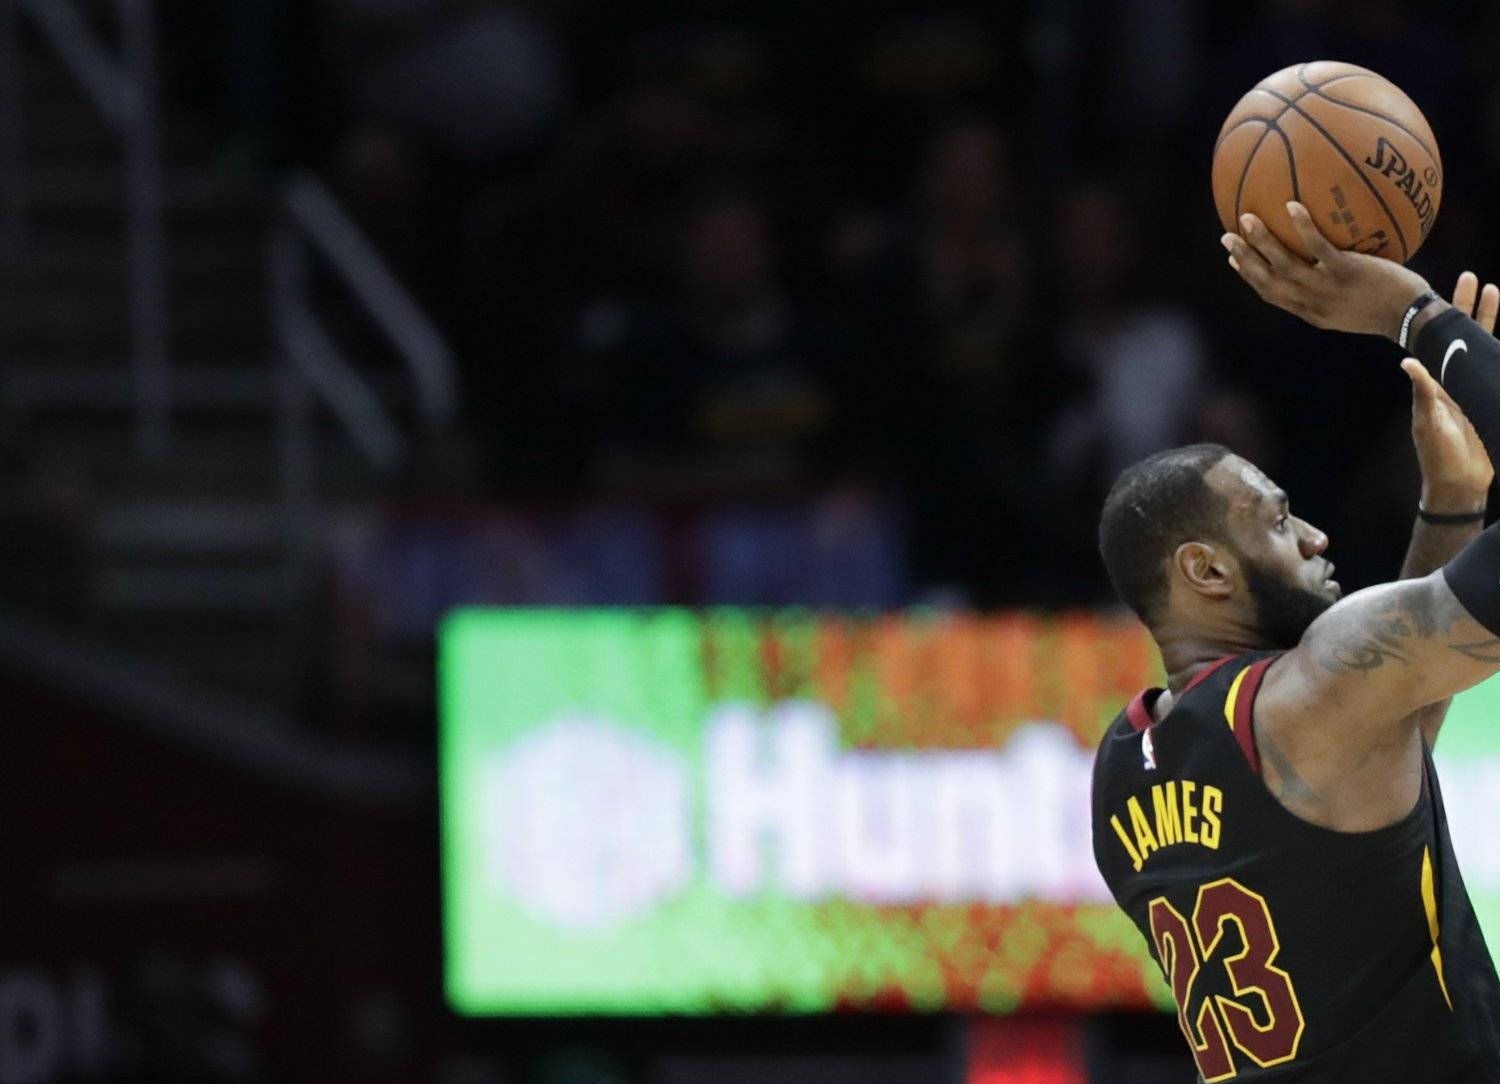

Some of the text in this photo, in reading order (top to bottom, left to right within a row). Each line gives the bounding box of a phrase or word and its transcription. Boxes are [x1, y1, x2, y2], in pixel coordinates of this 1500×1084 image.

[1365, 137, 1433, 232] SPALD
[1110, 780, 1223, 873] JAMES
[1149, 878, 1305, 1084] 23
